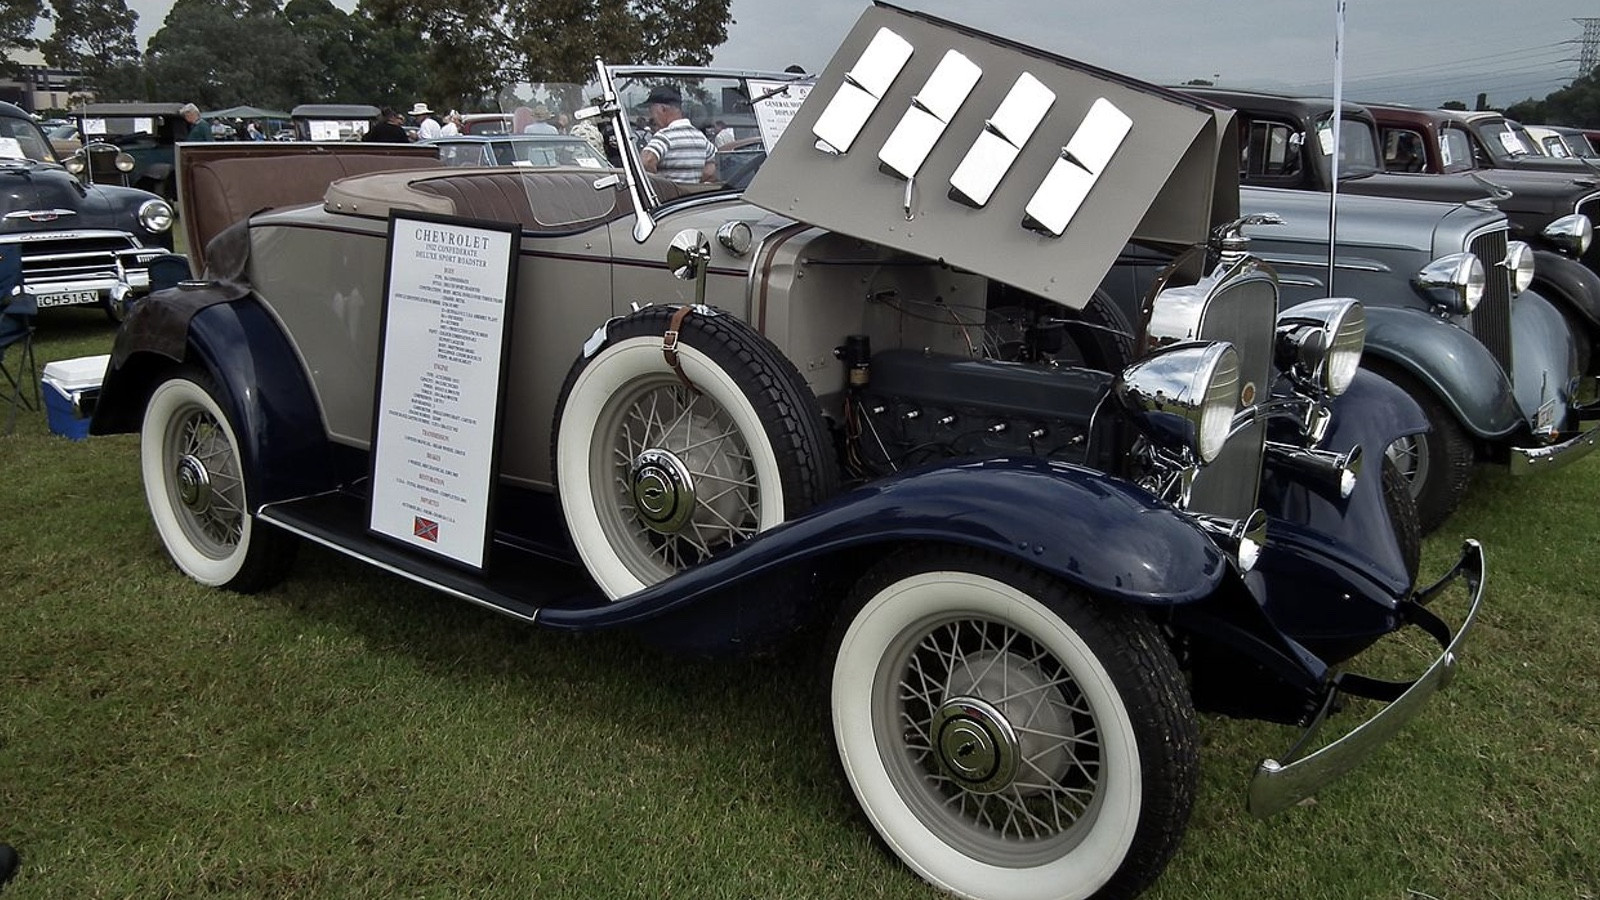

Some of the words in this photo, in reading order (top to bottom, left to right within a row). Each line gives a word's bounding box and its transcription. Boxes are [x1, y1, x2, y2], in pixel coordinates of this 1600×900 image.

[415, 227, 490, 250] CHEVROLET
[415, 250, 437, 260] DELUXE
[438, 253, 457, 263] SPORT
[457, 255, 488, 268] ROADSTER
[437, 245, 478, 258] CONFEDERATE
